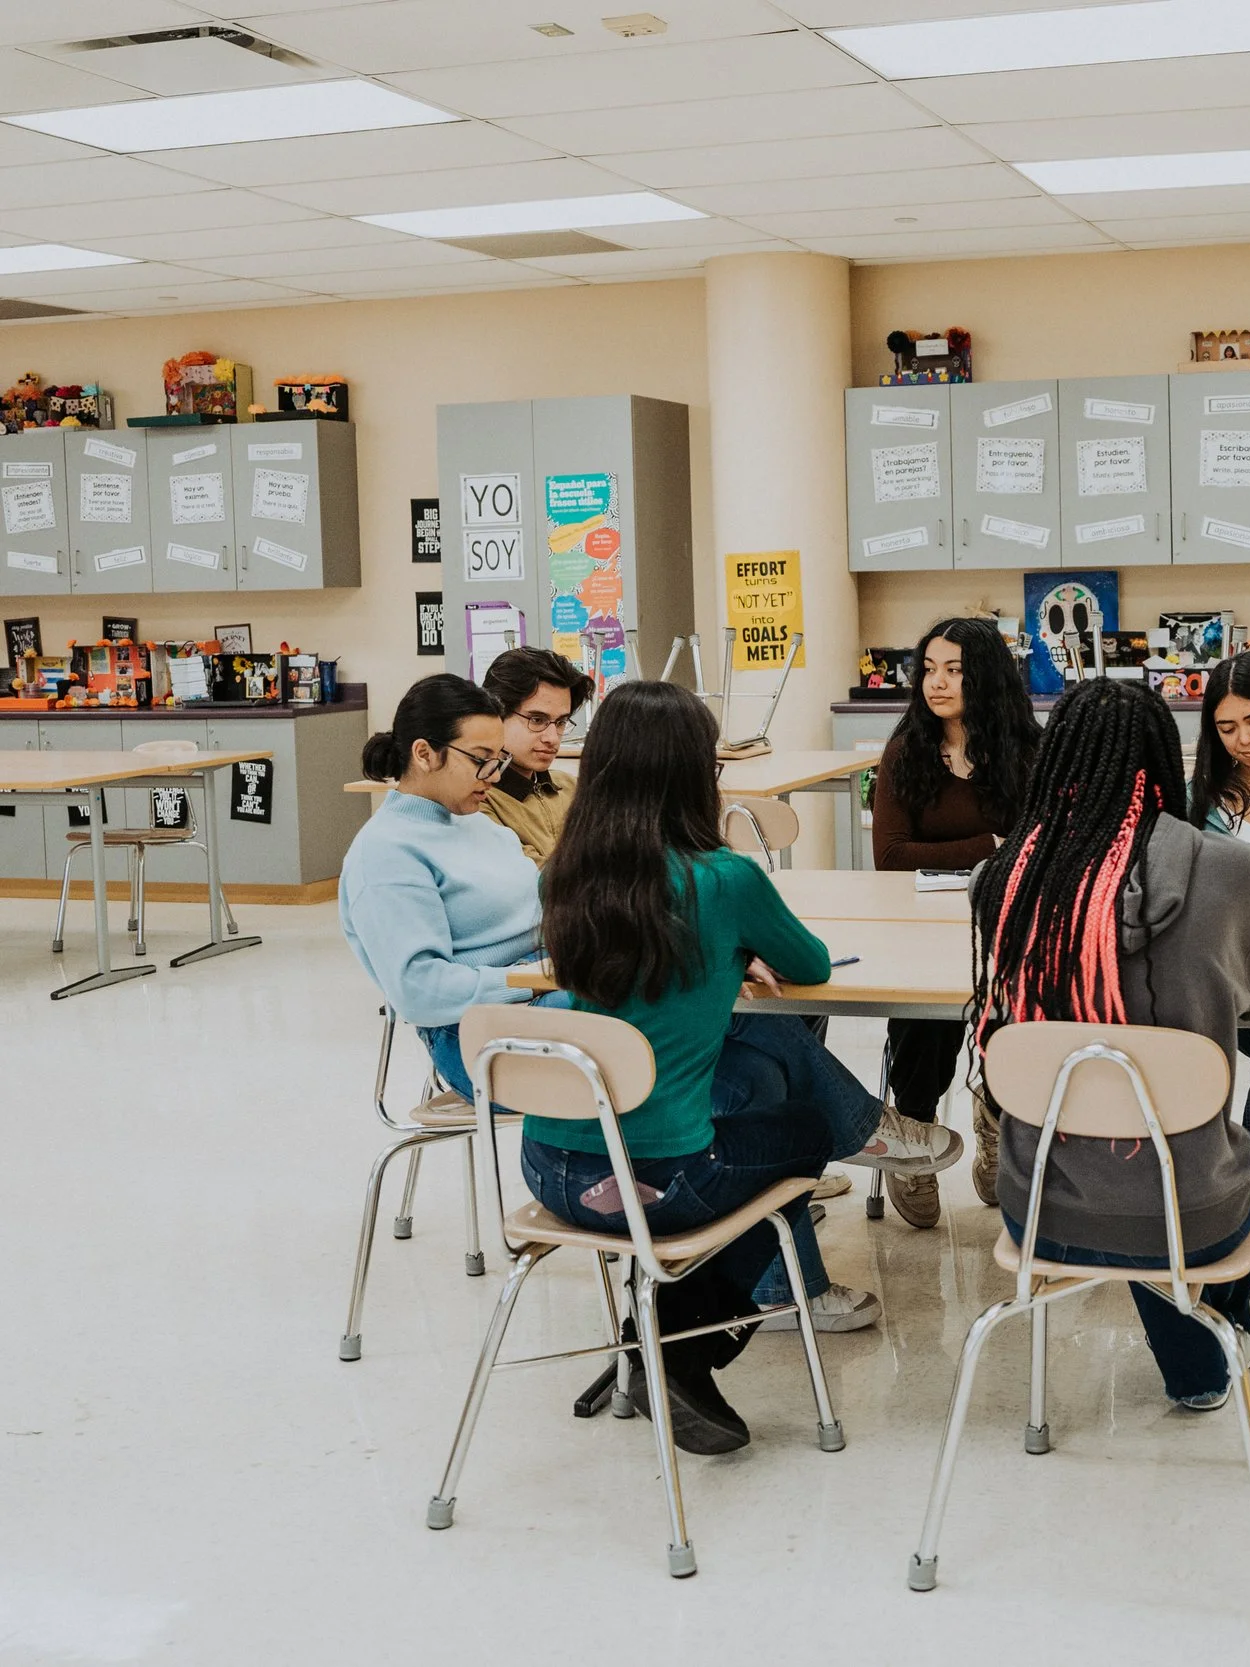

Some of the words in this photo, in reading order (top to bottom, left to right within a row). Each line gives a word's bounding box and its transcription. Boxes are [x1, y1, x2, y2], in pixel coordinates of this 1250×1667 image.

[883, 457, 929, 468] ¿Trabajamos
[895, 465, 926, 475] parejas?
[470, 484, 513, 517] YO
[424, 508, 438, 519] BIG
[415, 520, 440, 528] JOURNE
[416, 529, 436, 537] BEGIN
[418, 542, 440, 554] STEP
[472, 539, 516, 571] SOY
[737, 560, 786, 578] EFFORT
[745, 577, 778, 586] turns
[420, 612, 444, 621] DREAM
[751, 616, 774, 624] into
[421, 621, 435, 630] YOU
[422, 631, 437, 645] DO
[742, 625, 788, 643] GOALS
[747, 644, 785, 662] MET!
[78, 806, 90, 816] YO
